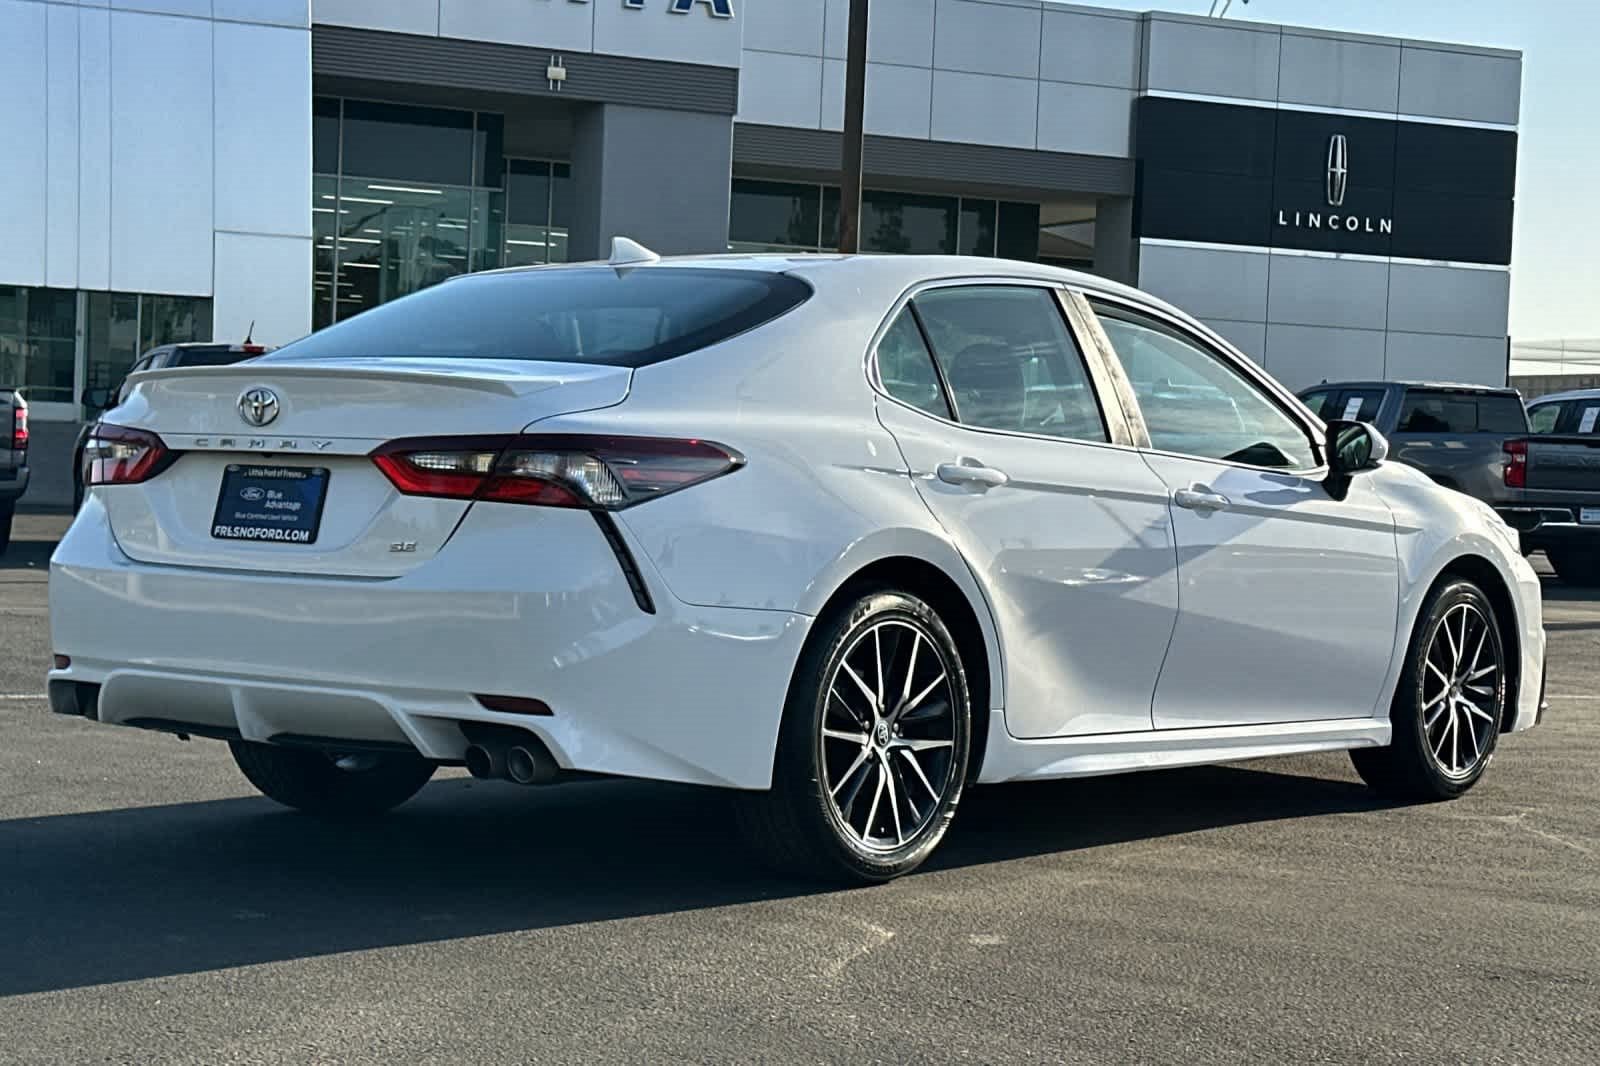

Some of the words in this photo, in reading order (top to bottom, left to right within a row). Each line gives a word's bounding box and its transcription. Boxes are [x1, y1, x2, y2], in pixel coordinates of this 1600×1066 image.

[1279, 210, 1392, 234] LINCOLN
[194, 437, 333, 450] CAMRY
[264, 468, 276, 477] Ford
[267, 490, 283, 499] Blue
[264, 500, 302, 511] Advantage
[214, 525, 309, 541] FRESNOFORD.COM
